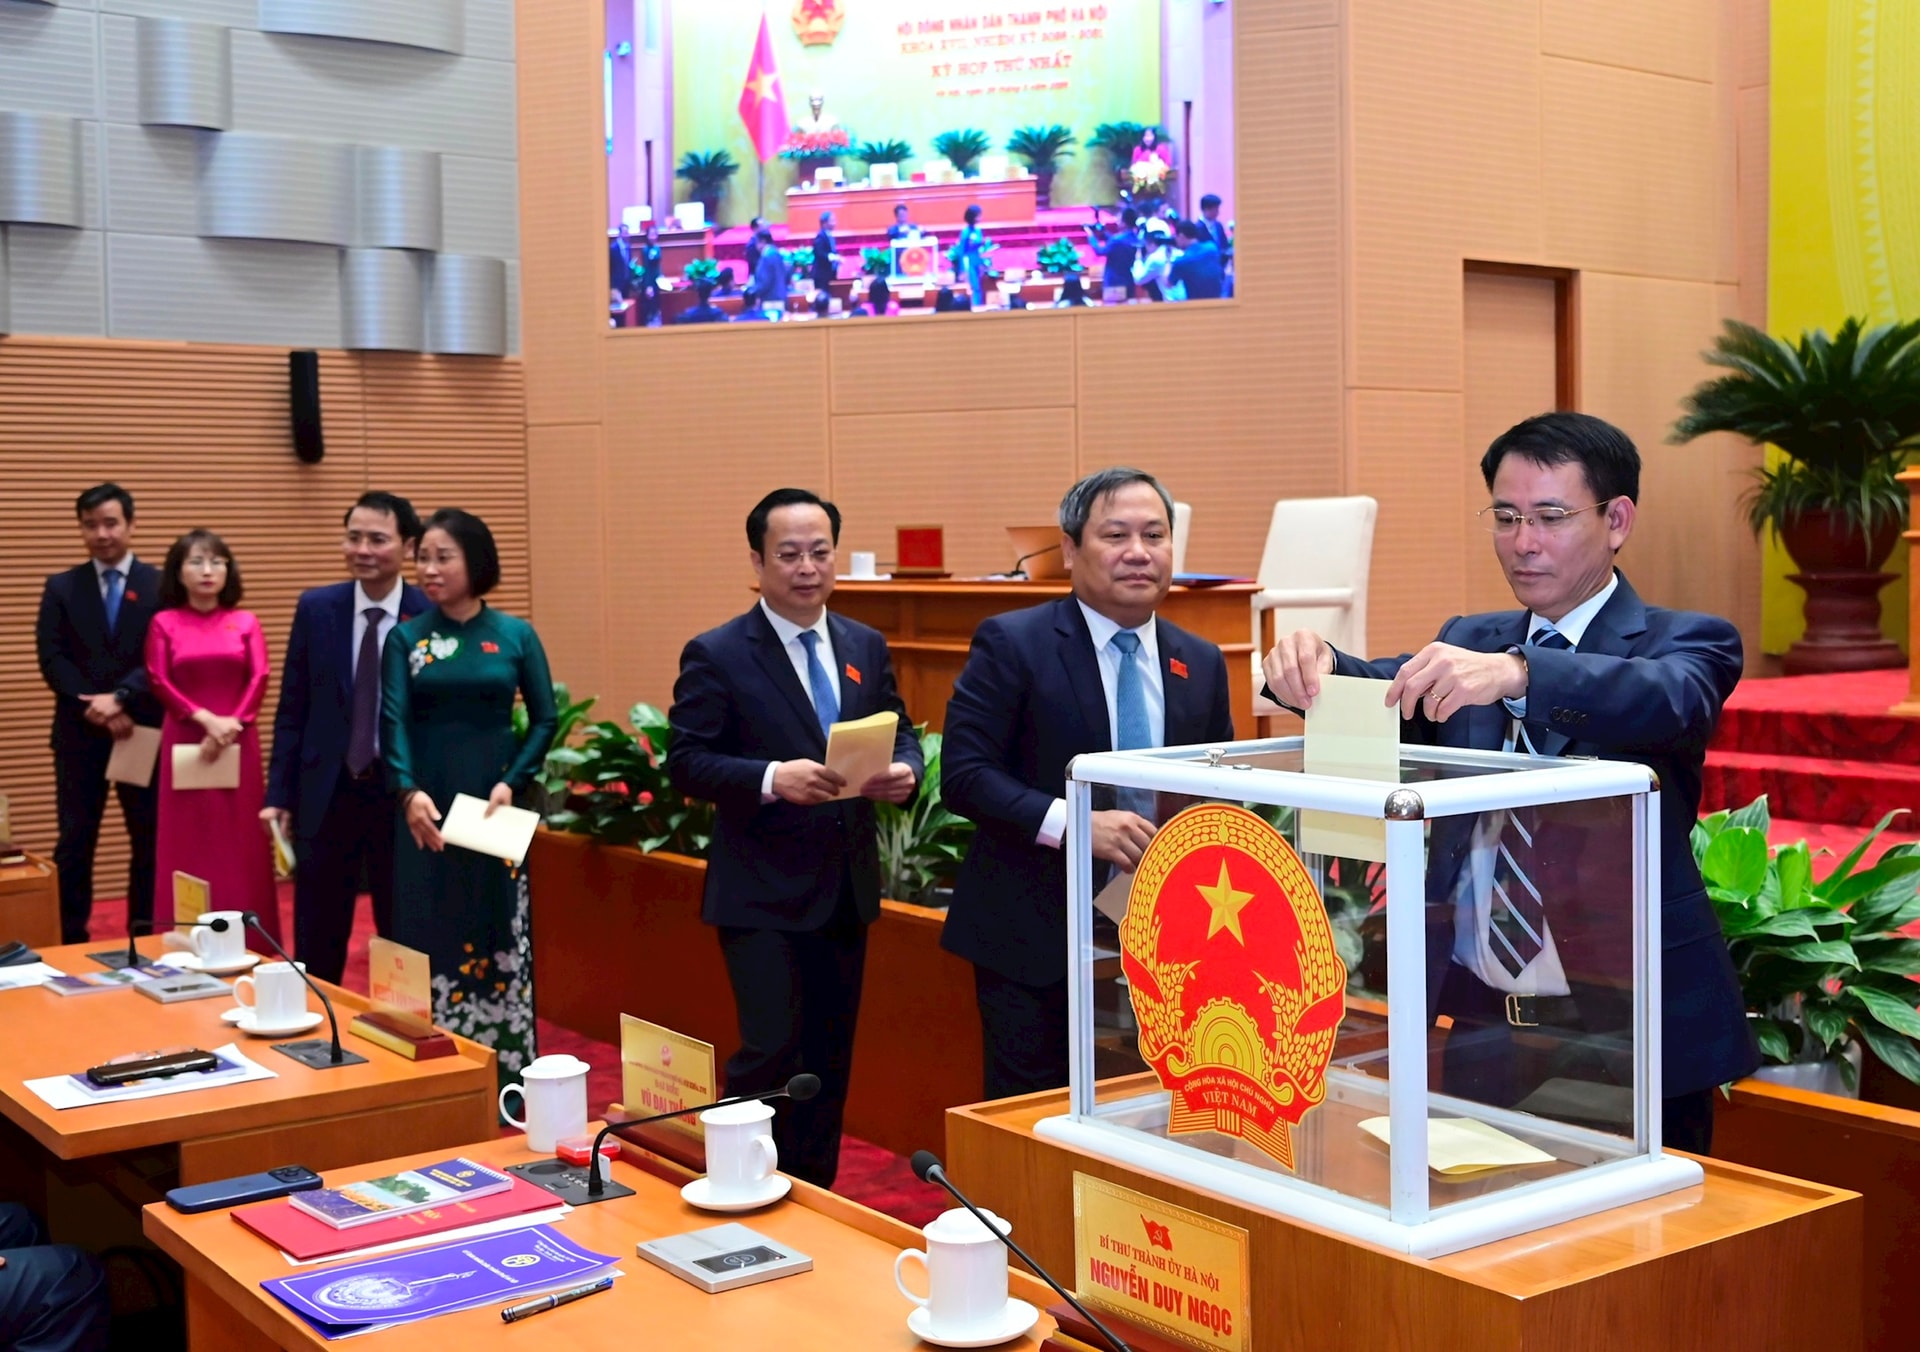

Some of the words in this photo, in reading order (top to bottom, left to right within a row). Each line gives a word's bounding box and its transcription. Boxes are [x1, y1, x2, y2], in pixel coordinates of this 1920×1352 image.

[1184, 1078, 1201, 1092] CỘNG
[1201, 1087, 1229, 1106] VIỆT
[1231, 1095, 1258, 1118] NAM
[1100, 1234, 1110, 1249] BÍ
[1110, 1239, 1131, 1257] THƯ
[1132, 1247, 1166, 1271] THÀNH
[1168, 1258, 1182, 1277] ỦY
[1184, 1266, 1198, 1283] HÀ
[1200, 1273, 1220, 1293] NỘI
[1090, 1257, 1150, 1304] NGUYỄN
[1153, 1281, 1183, 1316] DUY
[1188, 1295, 1232, 1338] NGỌC
